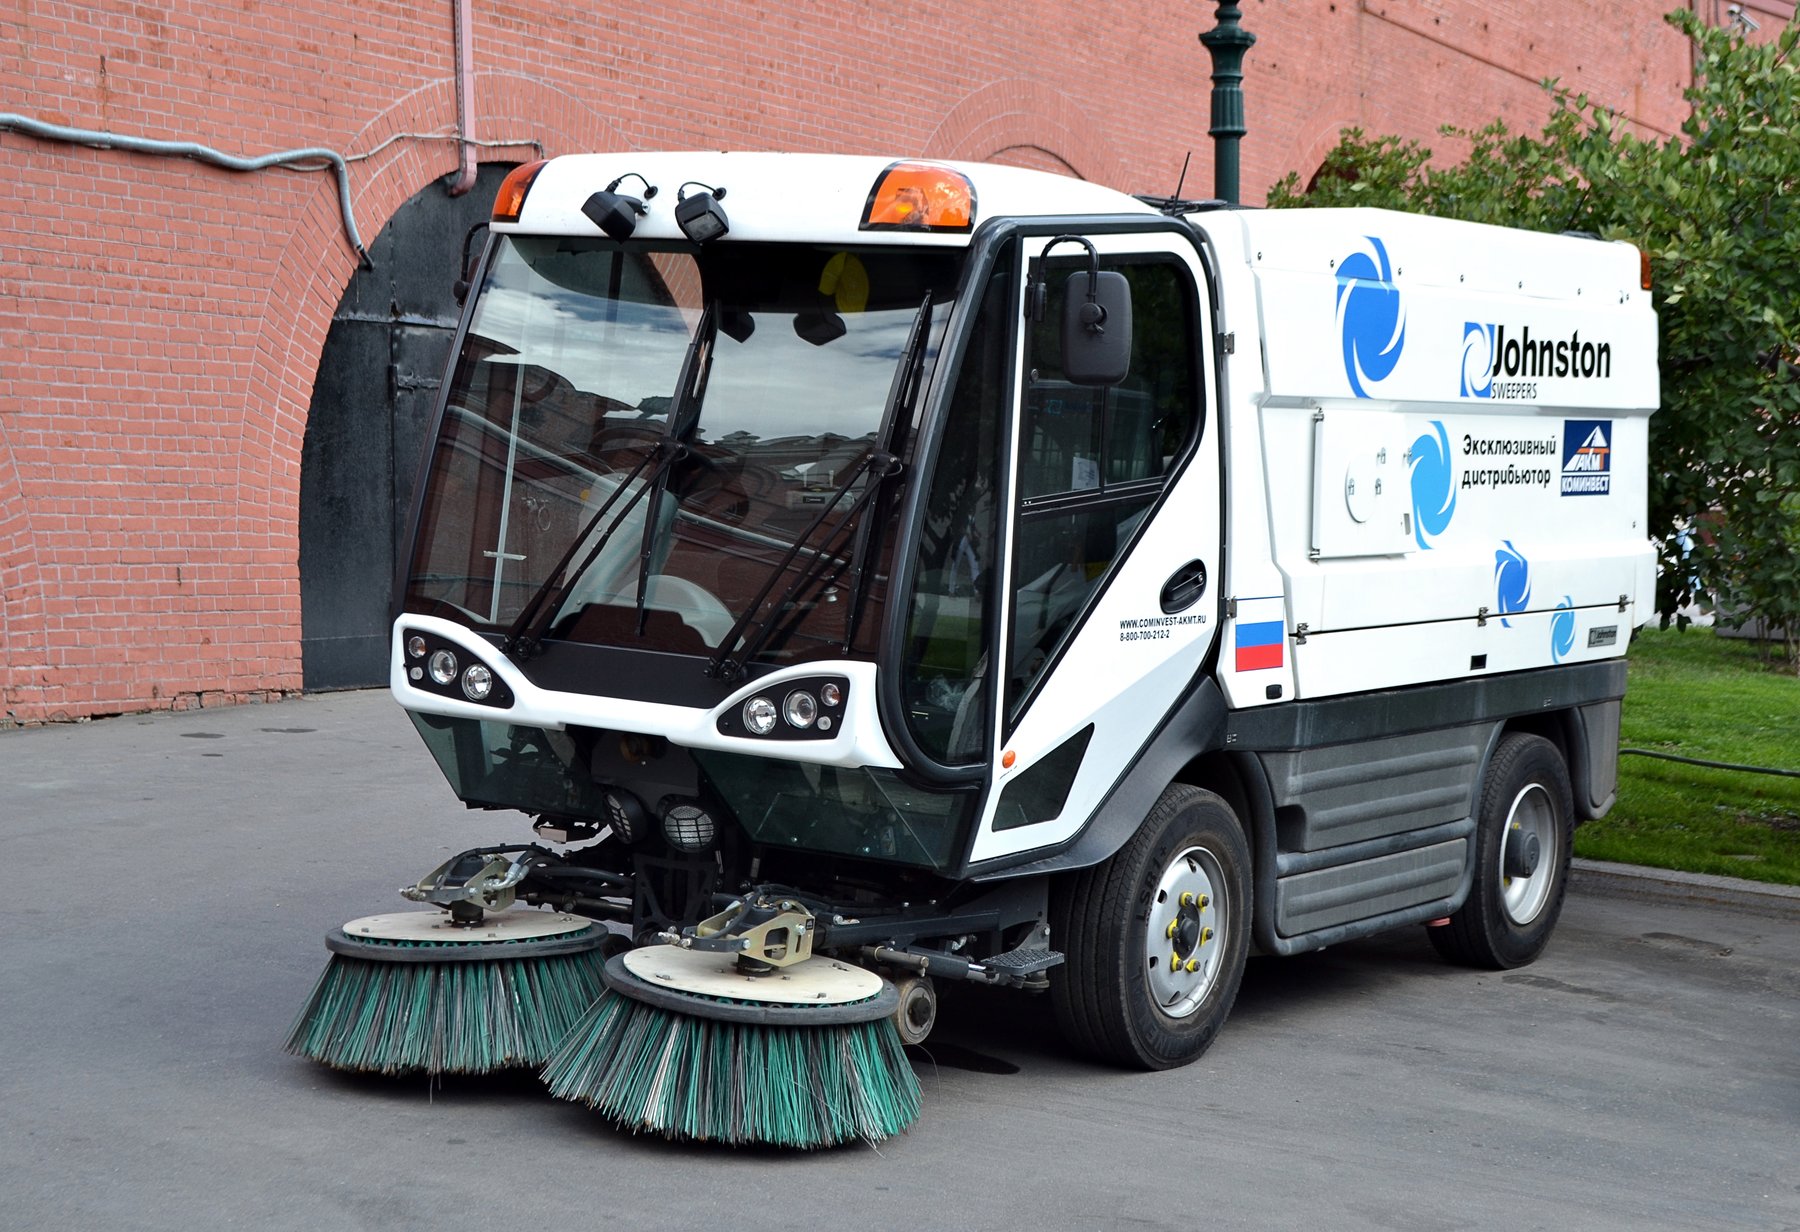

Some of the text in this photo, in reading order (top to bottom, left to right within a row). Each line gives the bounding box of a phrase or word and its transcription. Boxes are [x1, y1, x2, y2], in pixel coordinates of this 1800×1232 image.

[1492, 325, 1611, 378] Johnston
[1492, 382, 1537, 399] SWEEPERS
[1463, 434, 1557, 456] Эксклюзивный
[1462, 463, 1551, 489] дистрибьютор
[1561, 476, 1609, 492] КОМИНВЕСТ
[1120, 615, 1206, 630] WWW.COMINVEST-AKMT.RU
[1120, 629, 1170, 641] 8-800-700-212-2
